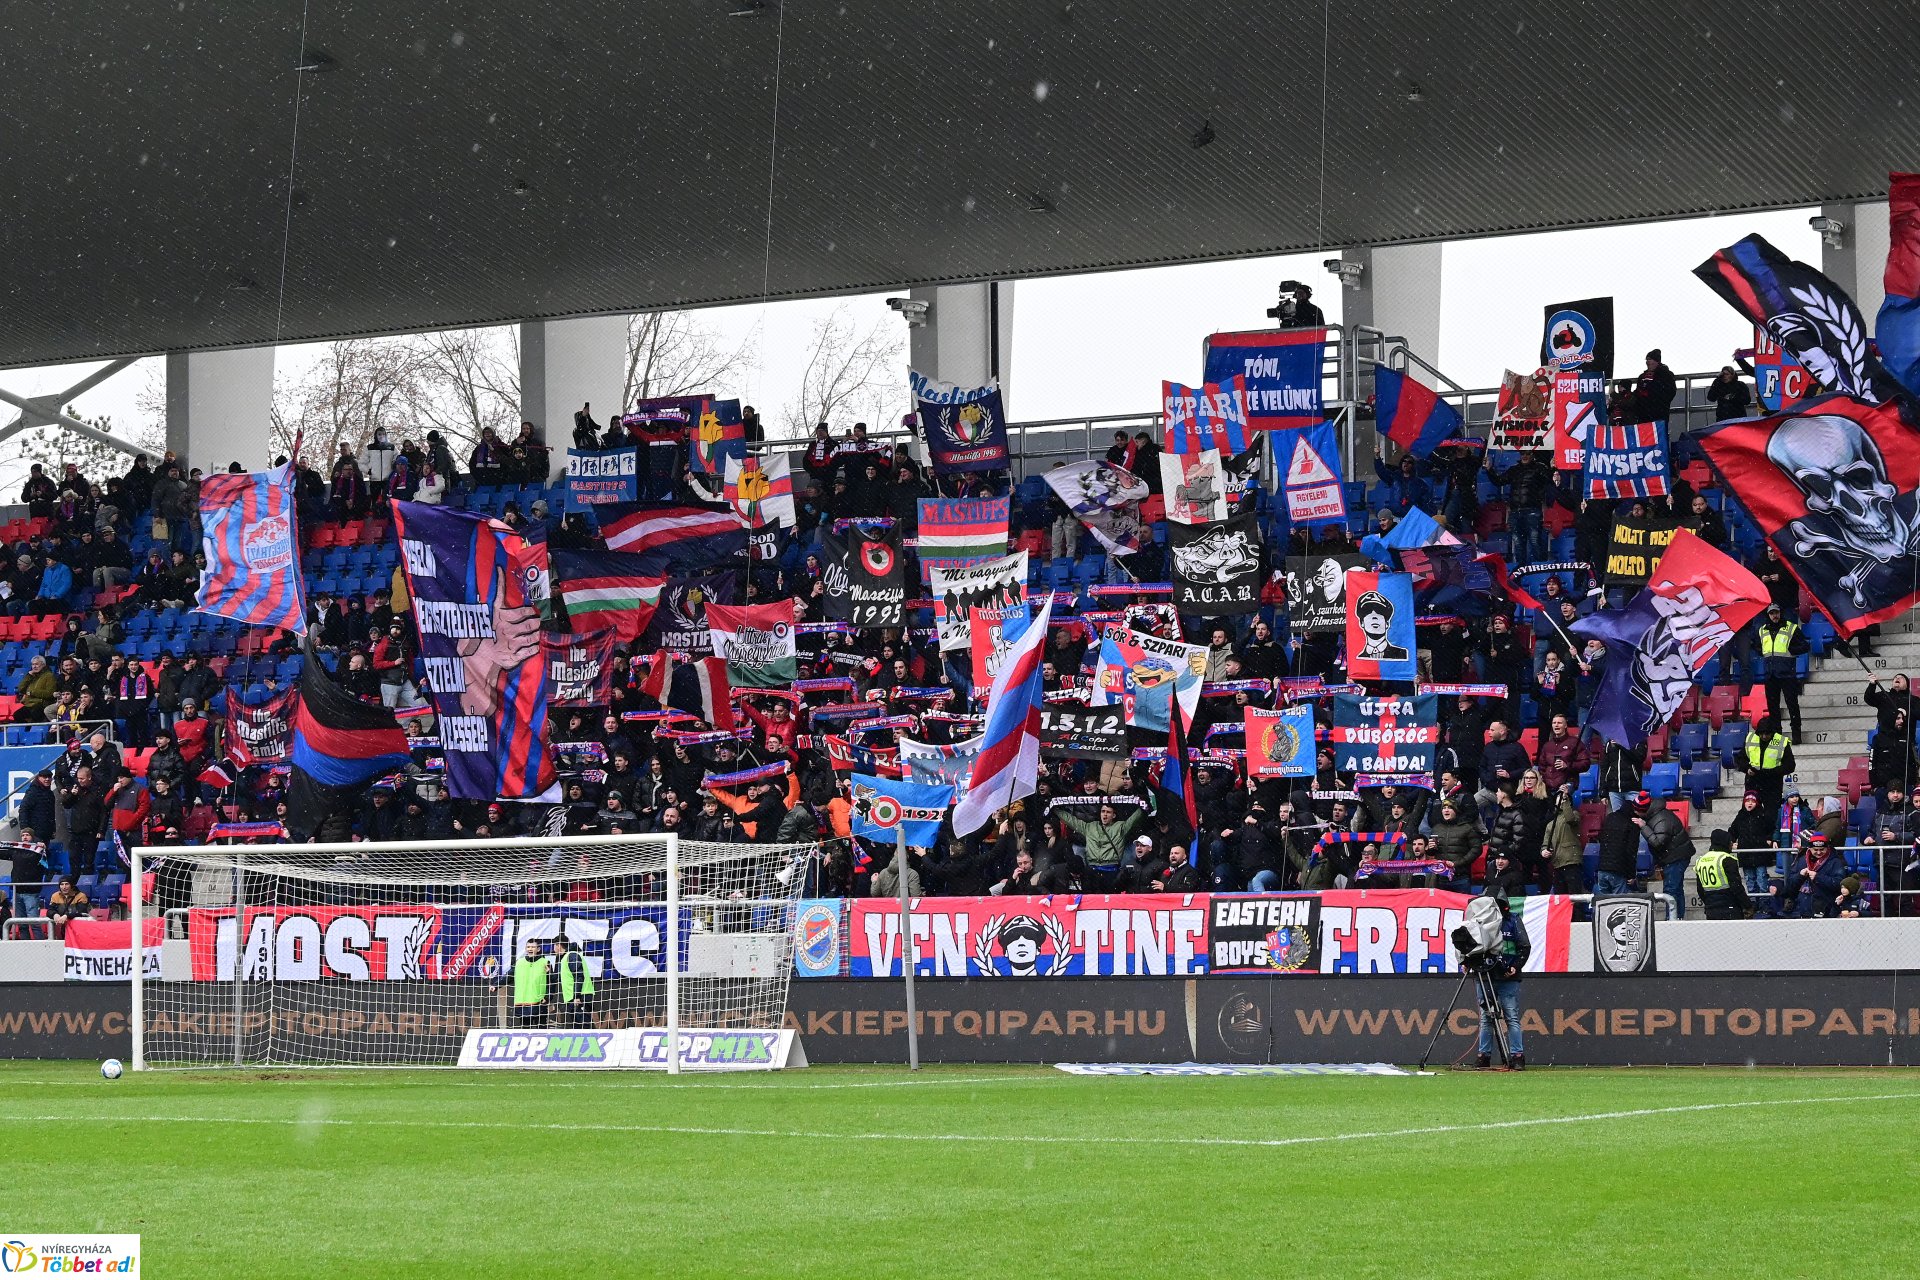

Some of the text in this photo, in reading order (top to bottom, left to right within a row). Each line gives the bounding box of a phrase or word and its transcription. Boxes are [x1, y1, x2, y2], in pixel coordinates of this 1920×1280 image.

[1244, 354, 1281, 381] TÓNI,
[1557, 378, 1604, 393] SZPARI
[1261, 384, 1318, 411] VELÜNK!
[1165, 389, 1248, 434] SZPARI
[1186, 424, 1225, 435] 1928
[1494, 420, 1549, 432] MISKOLC
[1493, 435, 1545, 447] AFRIKA
[950, 448, 997, 462] Mastiffs 1995
[1564, 448, 1586, 464] 192
[1589, 449, 1665, 476] NYSFC
[922, 497, 1009, 523] MASTIFFS
[941, 568, 966, 581] Mi
[970, 560, 1020, 582] vagyunk
[1607, 554, 1651, 576] MOLTO
[849, 584, 905, 604] Mastiffs
[1181, 585, 1256, 603] A.C.A.B.
[853, 603, 902, 624] 1995
[1304, 603, 1315, 616] A
[1105, 627, 1187, 659] SÖR & SZPARI
[1875, 659, 1887, 668] 09
[1359, 697, 1415, 717] ÚJRA
[1846, 696, 1858, 705] 08
[1040, 711, 1125, 735] 1.3.1.2.
[1345, 722, 1428, 744] DÜBÖRÖG
[1081, 735, 1107, 745] Cops
[1816, 733, 1828, 742] 07
[1345, 756, 1426, 771] A BANDA!
[1216, 900, 1311, 927] EASTERN
[864, 898, 970, 977] VÉN
[1627, 905, 1642, 962] NYSFC
[1214, 941, 1268, 968] BOYS
